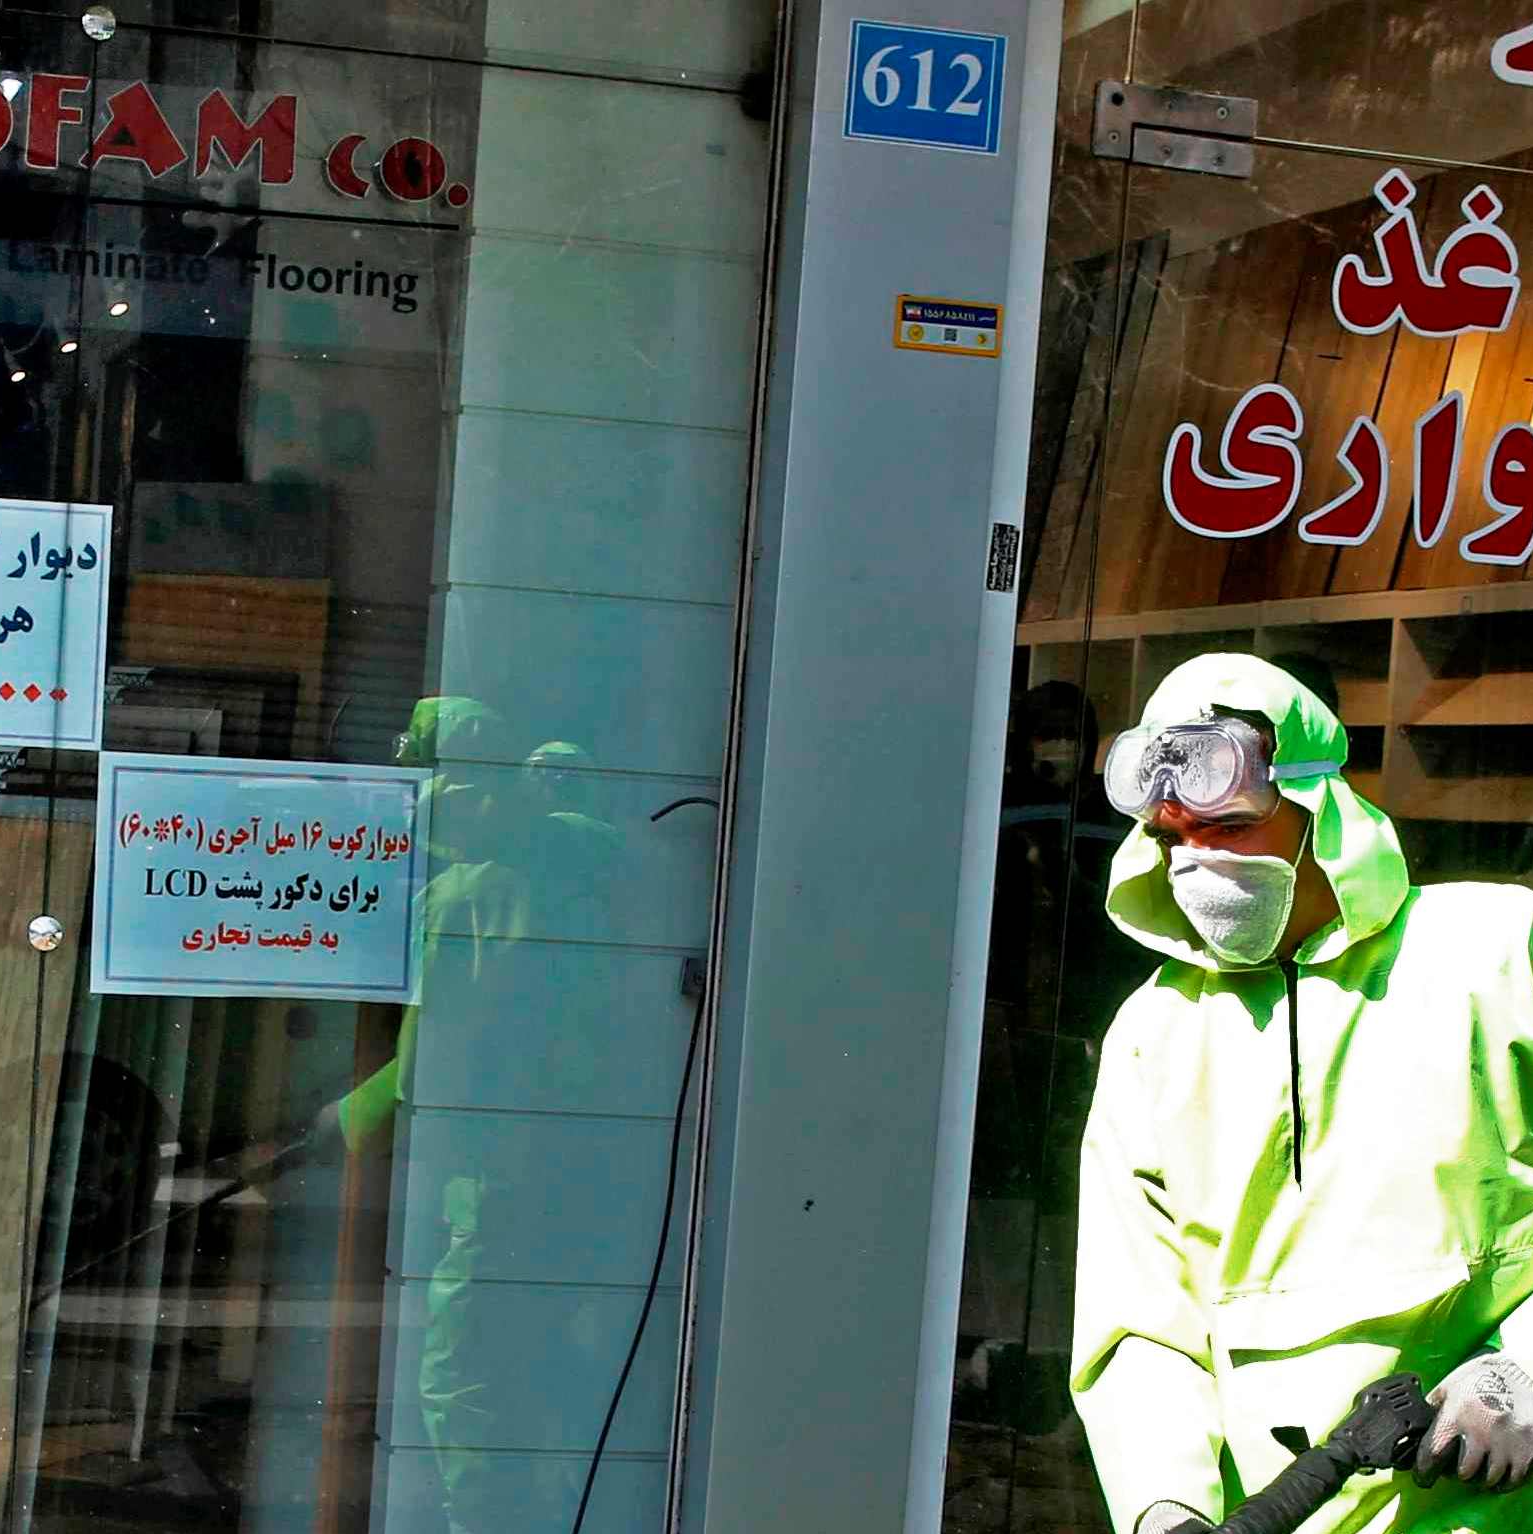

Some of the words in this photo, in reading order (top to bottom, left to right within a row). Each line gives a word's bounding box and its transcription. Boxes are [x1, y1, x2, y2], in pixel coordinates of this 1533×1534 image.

[862, 44, 984, 117] 612
[8, 239, 209, 284] Laminate
[241, 250, 419, 313] Flooring
[7, 531, 98, 580] دیوار
[208, 817, 262, 854] آجری
[266, 821, 295, 855] میل
[302, 820, 323, 851] ۱۶
[144, 867, 208, 897] LCD
[216, 871, 264, 909] پشت
[269, 873, 323, 910] دکور
[329, 875, 380, 913] برای
[181, 921, 251, 951] تجاری
[257, 922, 312, 953] قیمت
[318, 929, 339, 954] به
